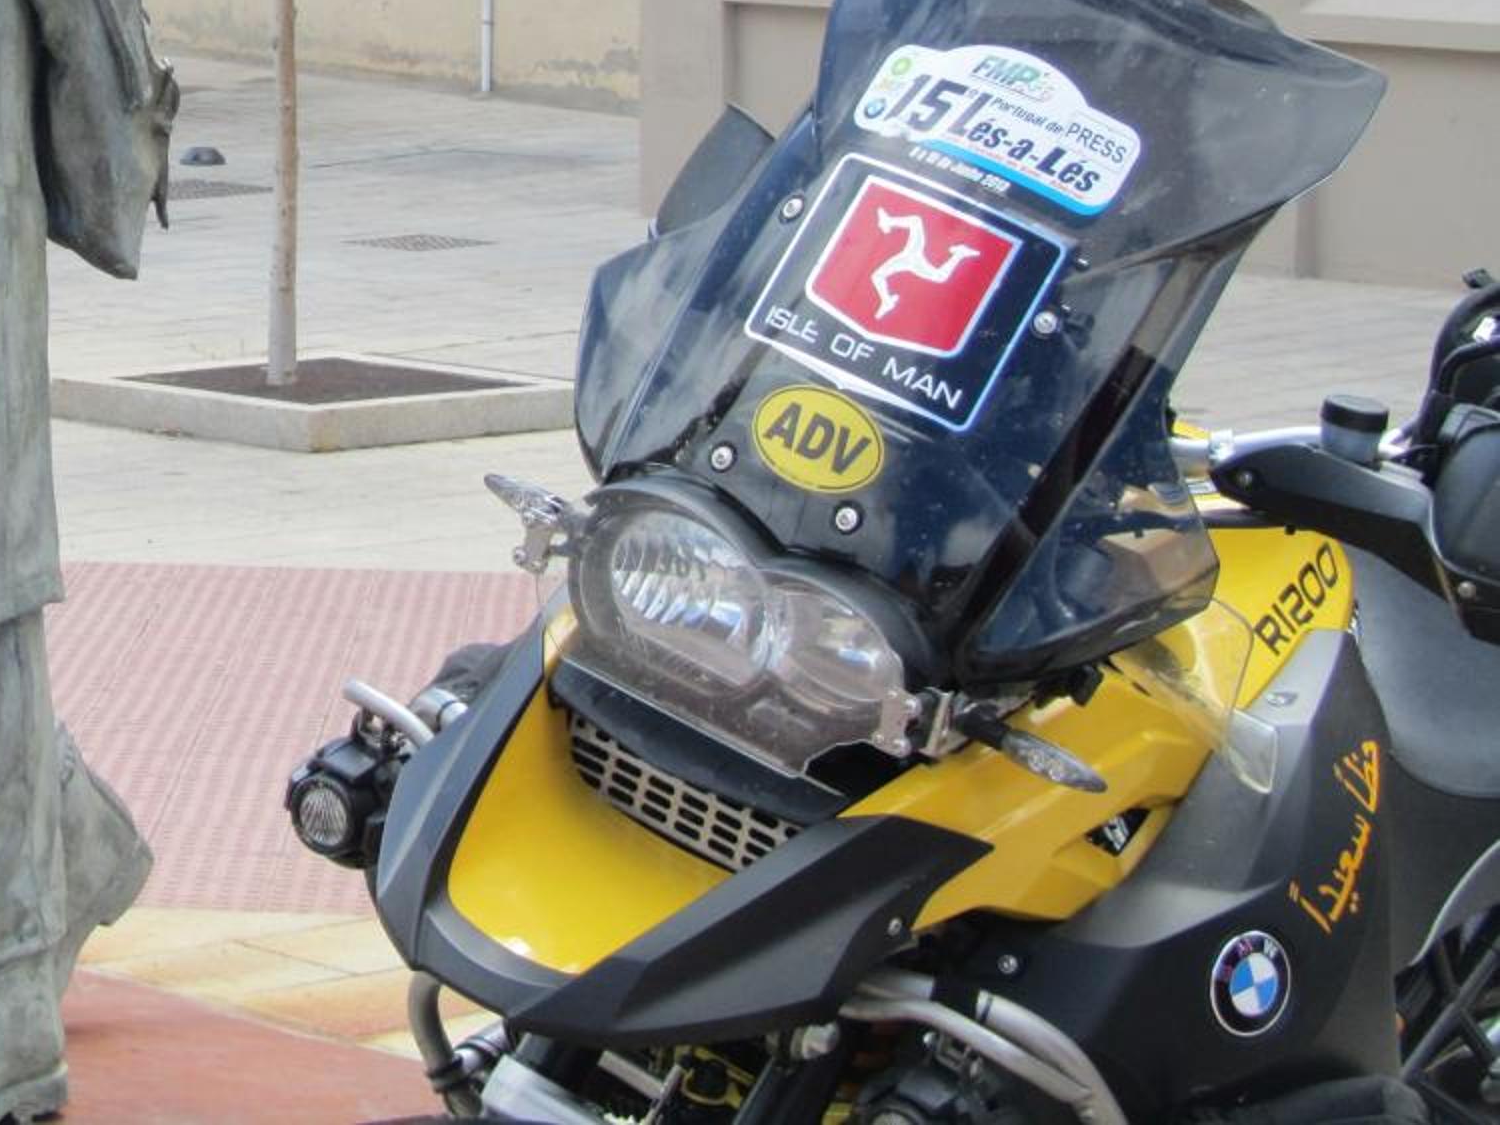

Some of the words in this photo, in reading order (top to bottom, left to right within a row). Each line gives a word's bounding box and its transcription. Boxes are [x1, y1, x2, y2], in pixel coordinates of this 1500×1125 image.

[990, 97, 1047, 125] Portugal
[1046, 116, 1063, 133] de
[1065, 122, 1127, 164] PRESS
[765, 305, 818, 343] ISLE
[830, 333, 875, 362] OF
[881, 357, 963, 410] MAN
[762, 401, 872, 475] ADV
[1253, 541, 1339, 656] R1200
